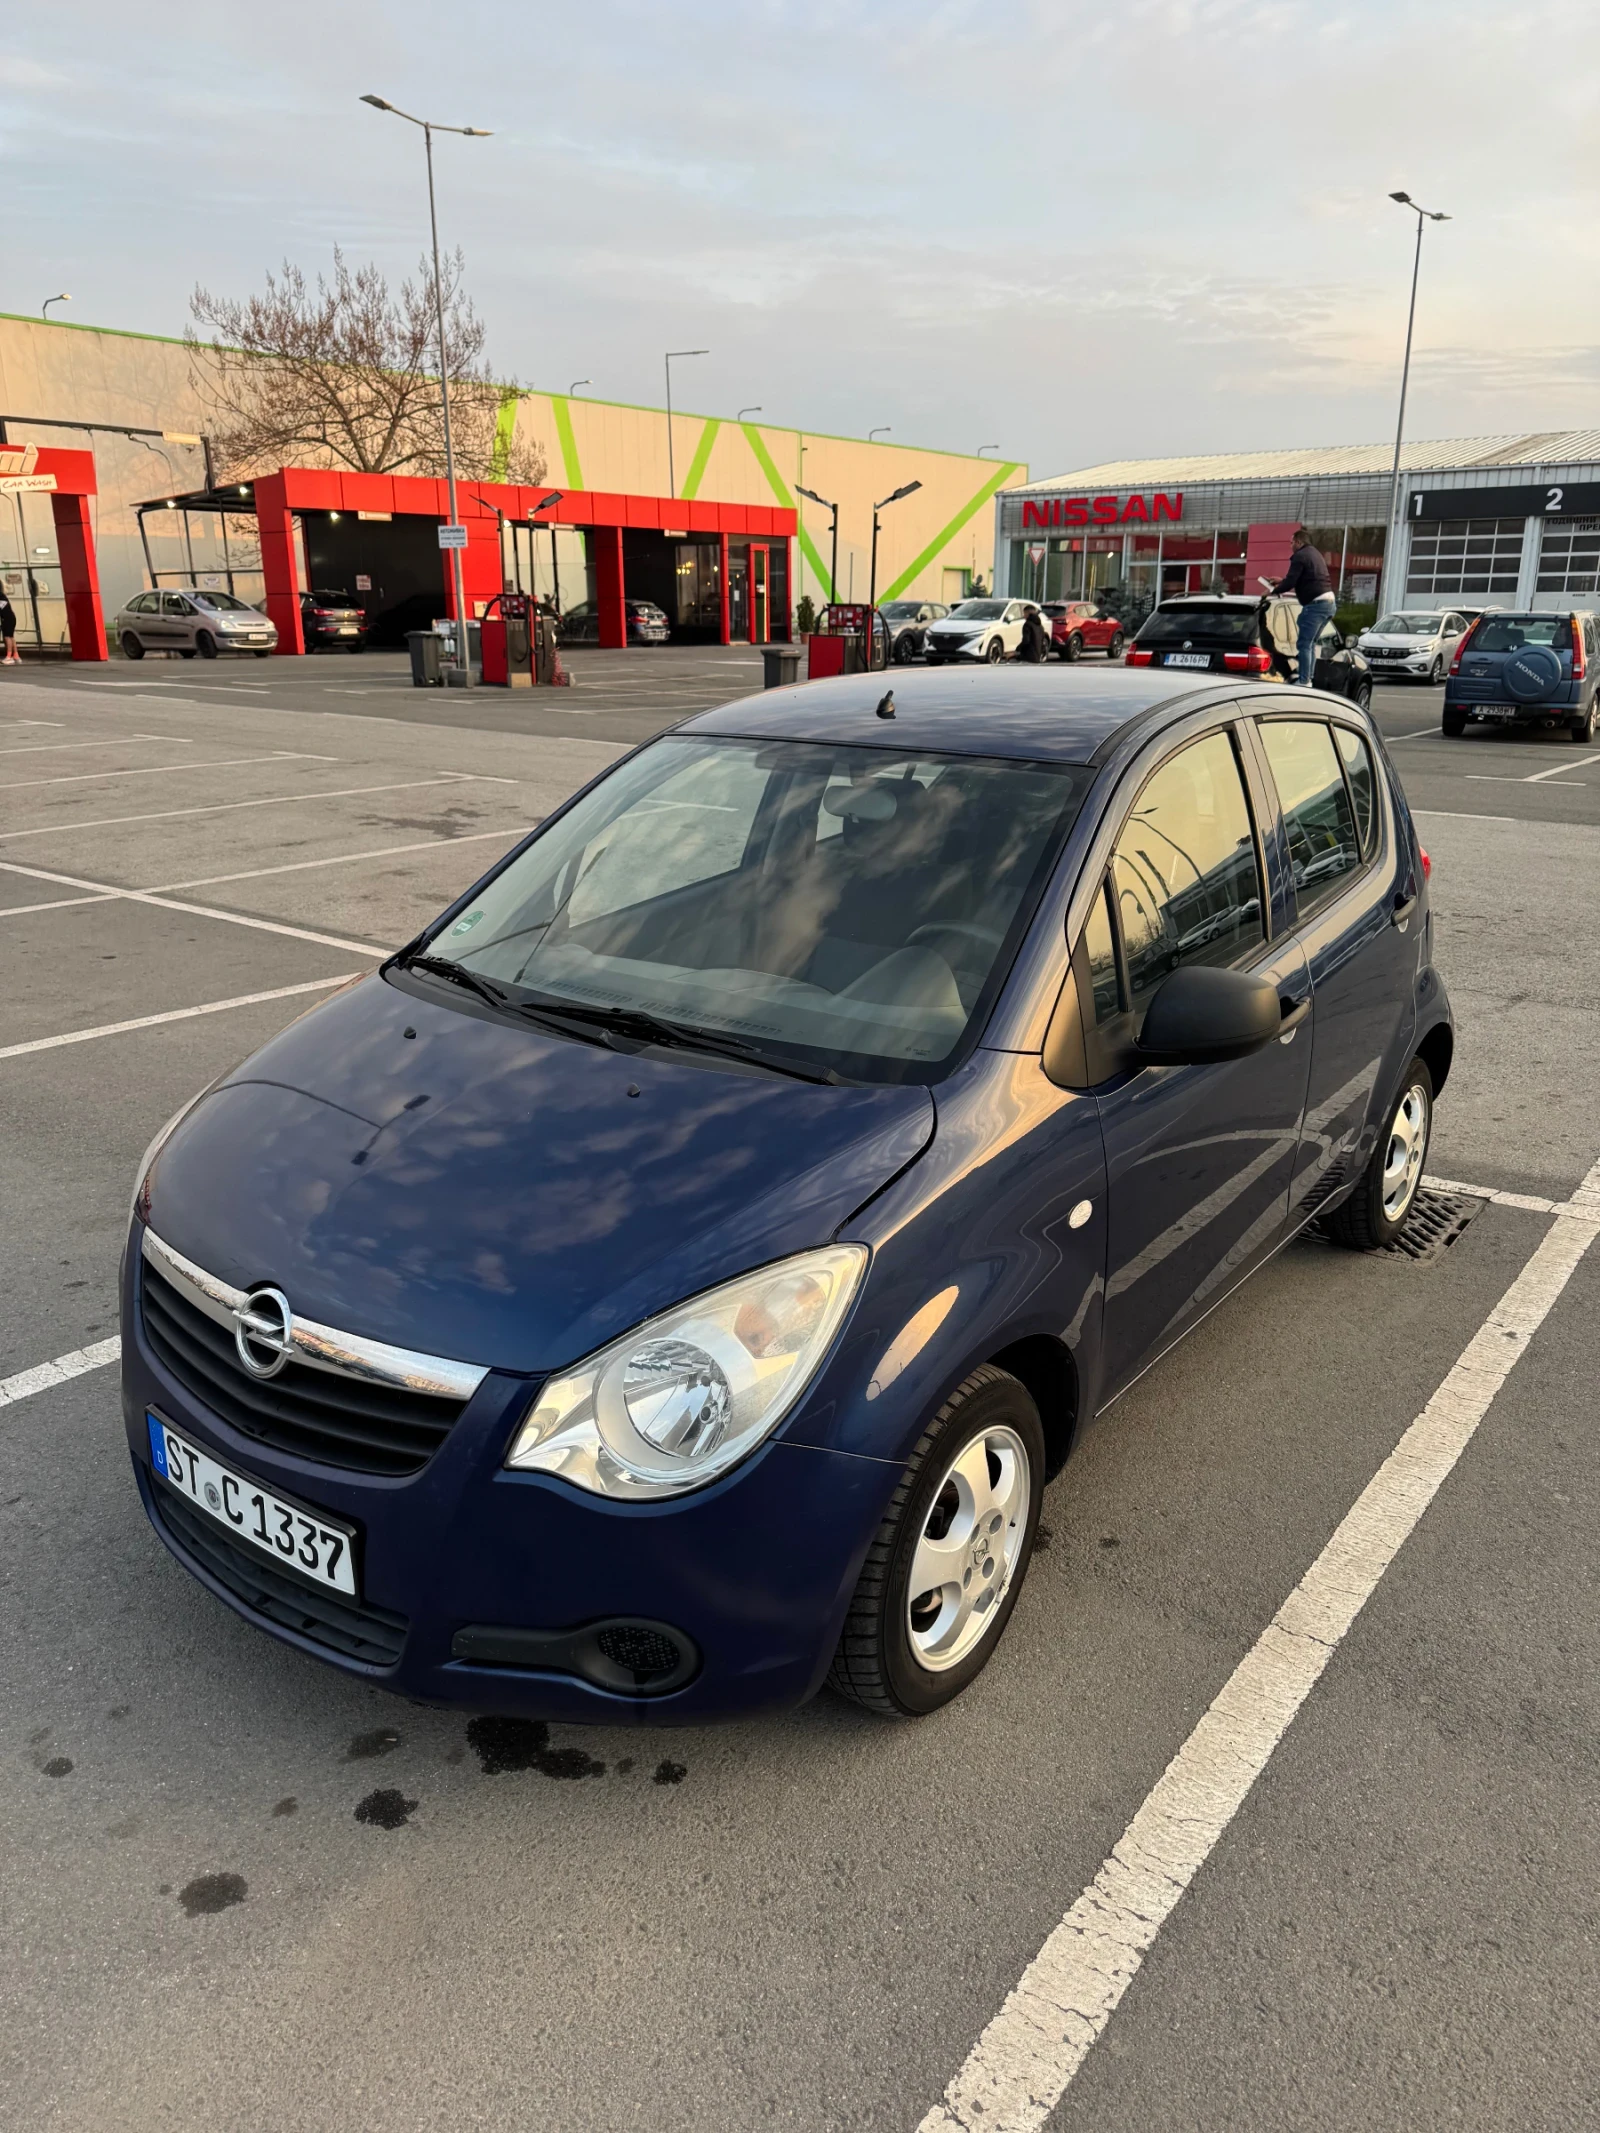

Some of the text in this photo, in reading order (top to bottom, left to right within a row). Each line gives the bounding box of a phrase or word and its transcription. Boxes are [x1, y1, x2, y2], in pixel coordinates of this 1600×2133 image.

[2, 479, 52, 488] CAR WASH
[1022, 493, 1183, 528] NISSAN
[1413, 494, 1424, 516] 1
[1545, 488, 1563, 511] 2
[1579, 523, 1600, 531] ПРЕ
[1515, 661, 1545, 686] HONDA
[157, 1434, 344, 1581] D ST C 1337
